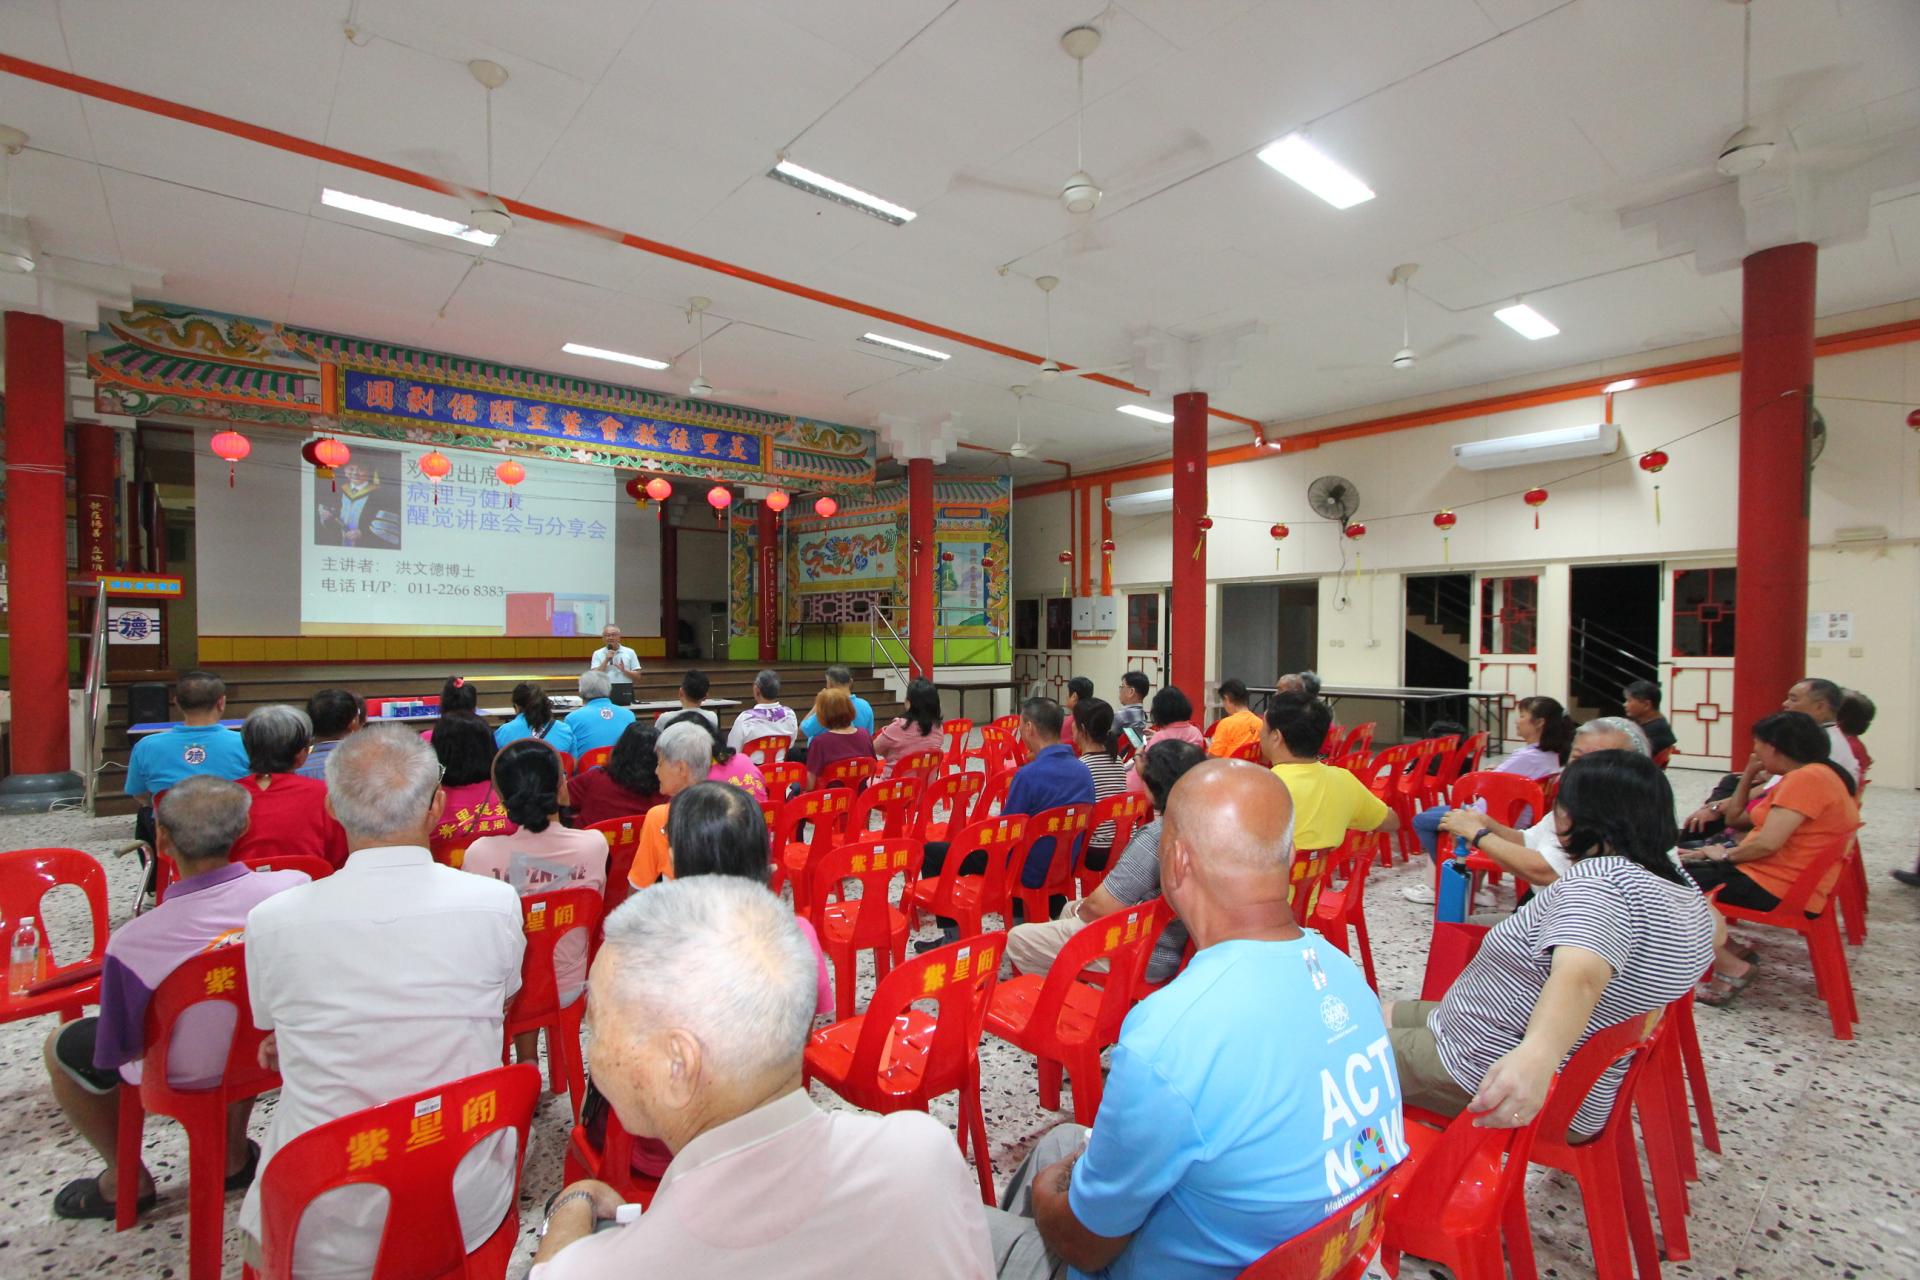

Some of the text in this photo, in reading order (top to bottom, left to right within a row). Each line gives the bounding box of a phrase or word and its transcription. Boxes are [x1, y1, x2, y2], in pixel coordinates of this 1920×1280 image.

[406, 482, 523, 511] 病理与健康
[406, 504, 608, 540] 醒觉讲座会与分享会
[395, 559, 476, 578] 洪文德博士
[321, 578, 356, 593] 电话
[407, 581, 472, 596] 011-2266
[1320, 1034, 1397, 1141] ACT
